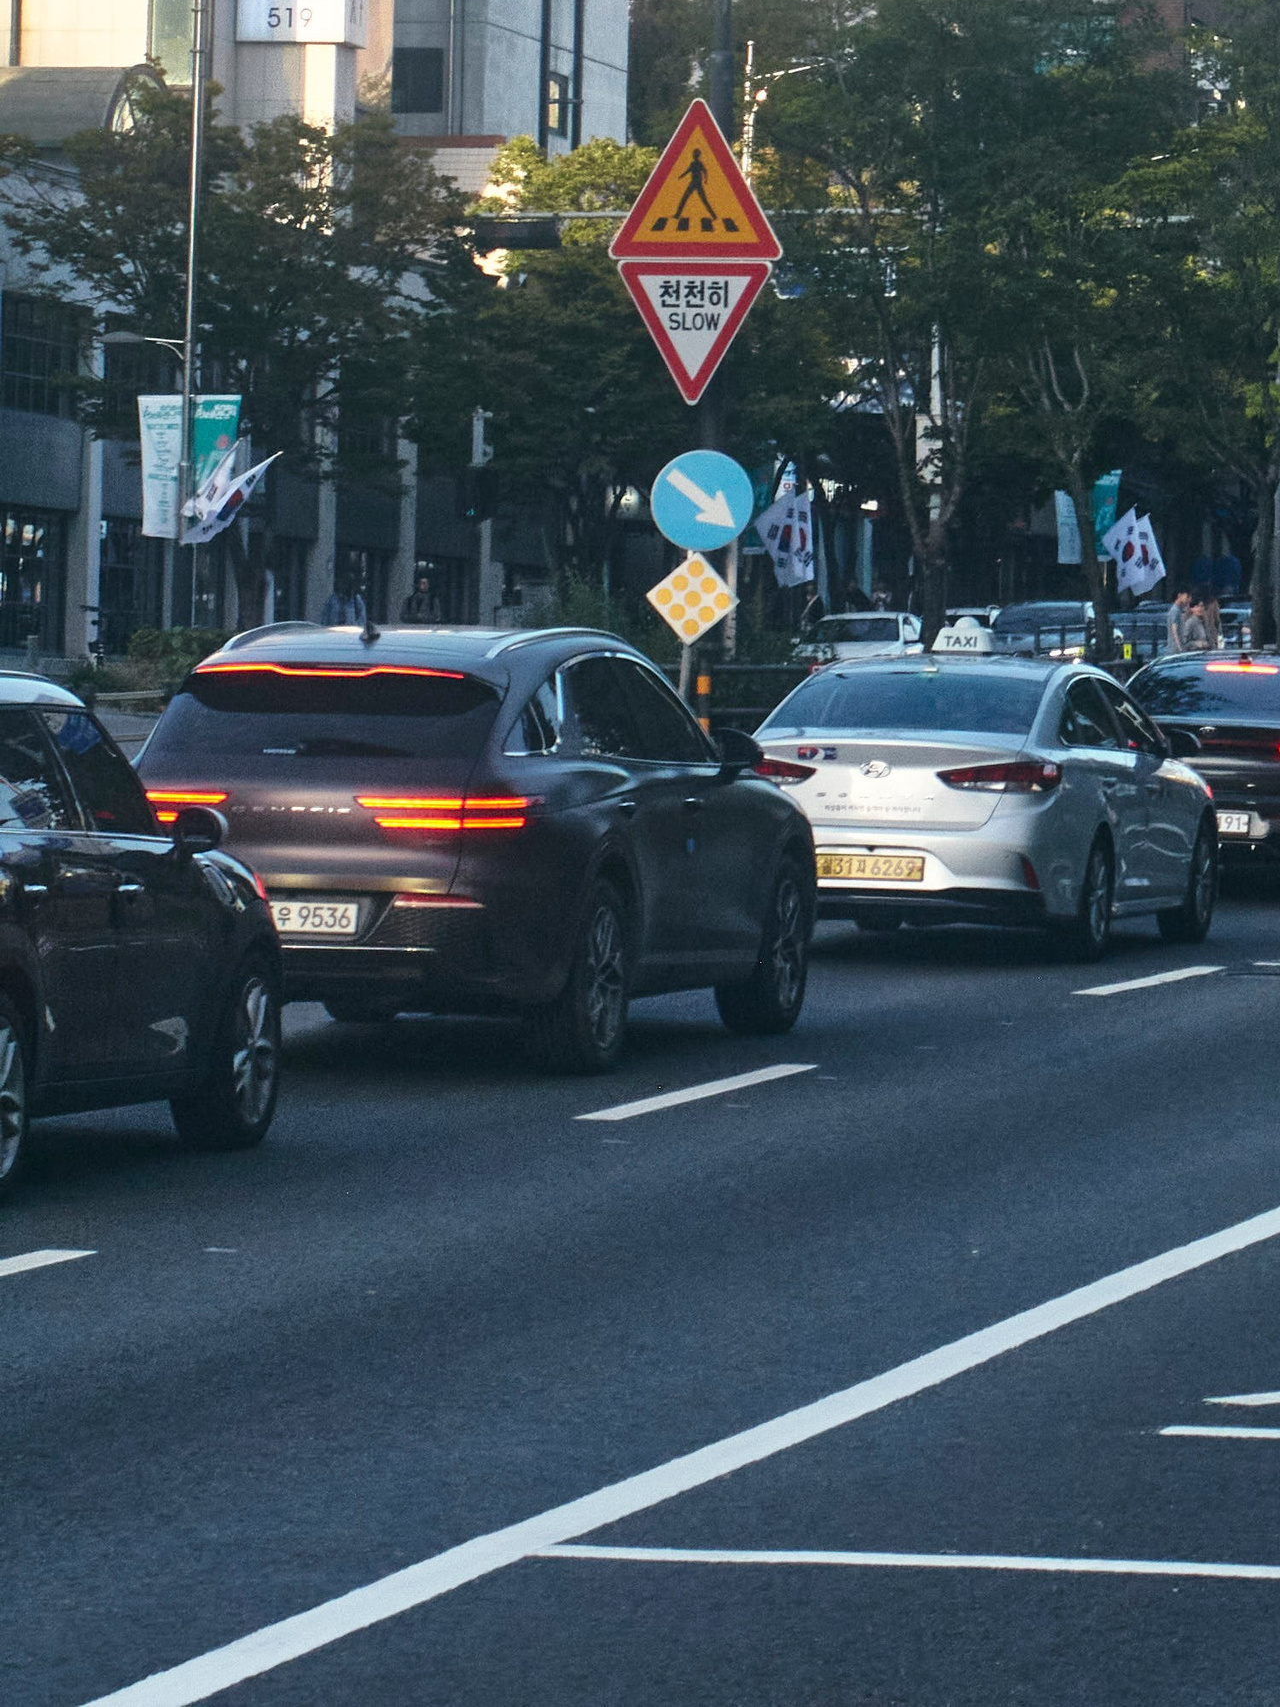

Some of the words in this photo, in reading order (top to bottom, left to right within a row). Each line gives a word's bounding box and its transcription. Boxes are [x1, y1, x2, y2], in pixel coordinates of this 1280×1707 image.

[267, 7, 313, 28] 519
[659, 280, 729, 309] 천천히
[669, 312, 721, 331] SLOW
[944, 636, 978, 648] TAXI
[298, 905, 351, 929] 9536
